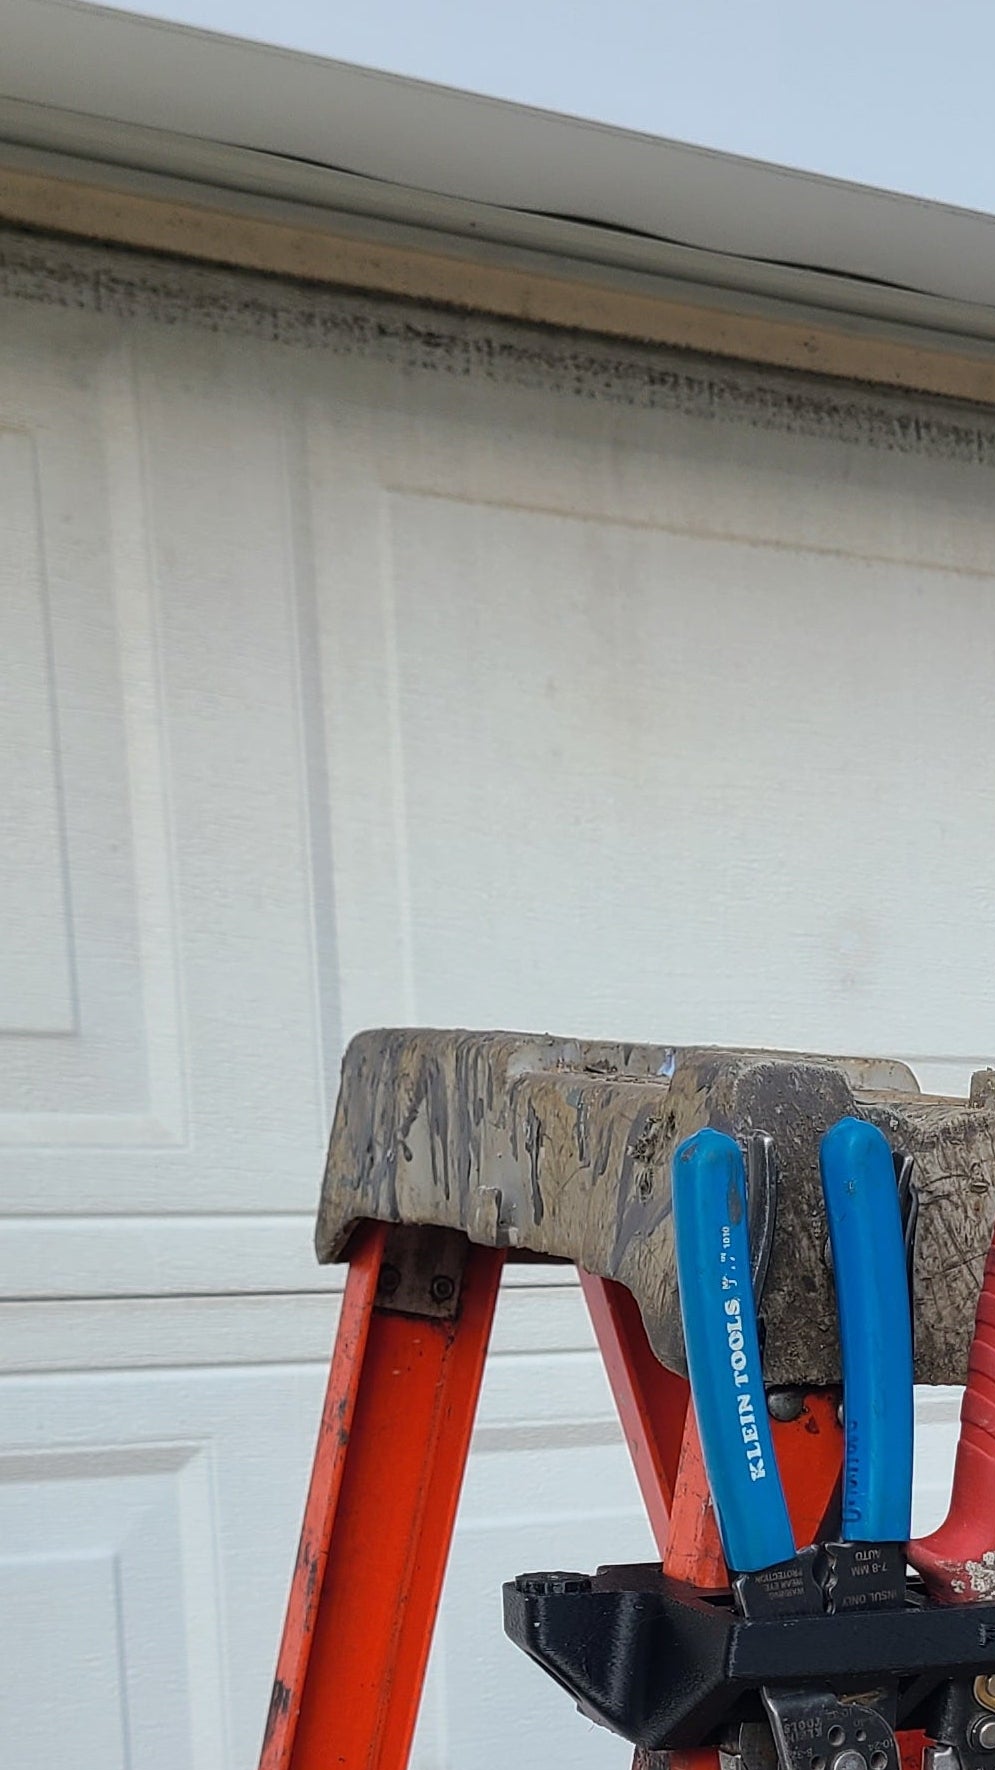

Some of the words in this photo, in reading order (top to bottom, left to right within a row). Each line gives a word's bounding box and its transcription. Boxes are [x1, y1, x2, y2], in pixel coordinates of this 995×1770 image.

[724, 1298, 749, 1388] TOOLS
[737, 1394, 766, 1481] KLEIN
[855, 1550, 881, 1561] AUTO
[851, 1566, 870, 1577] MM
[873, 1562, 887, 1573] 7-8
